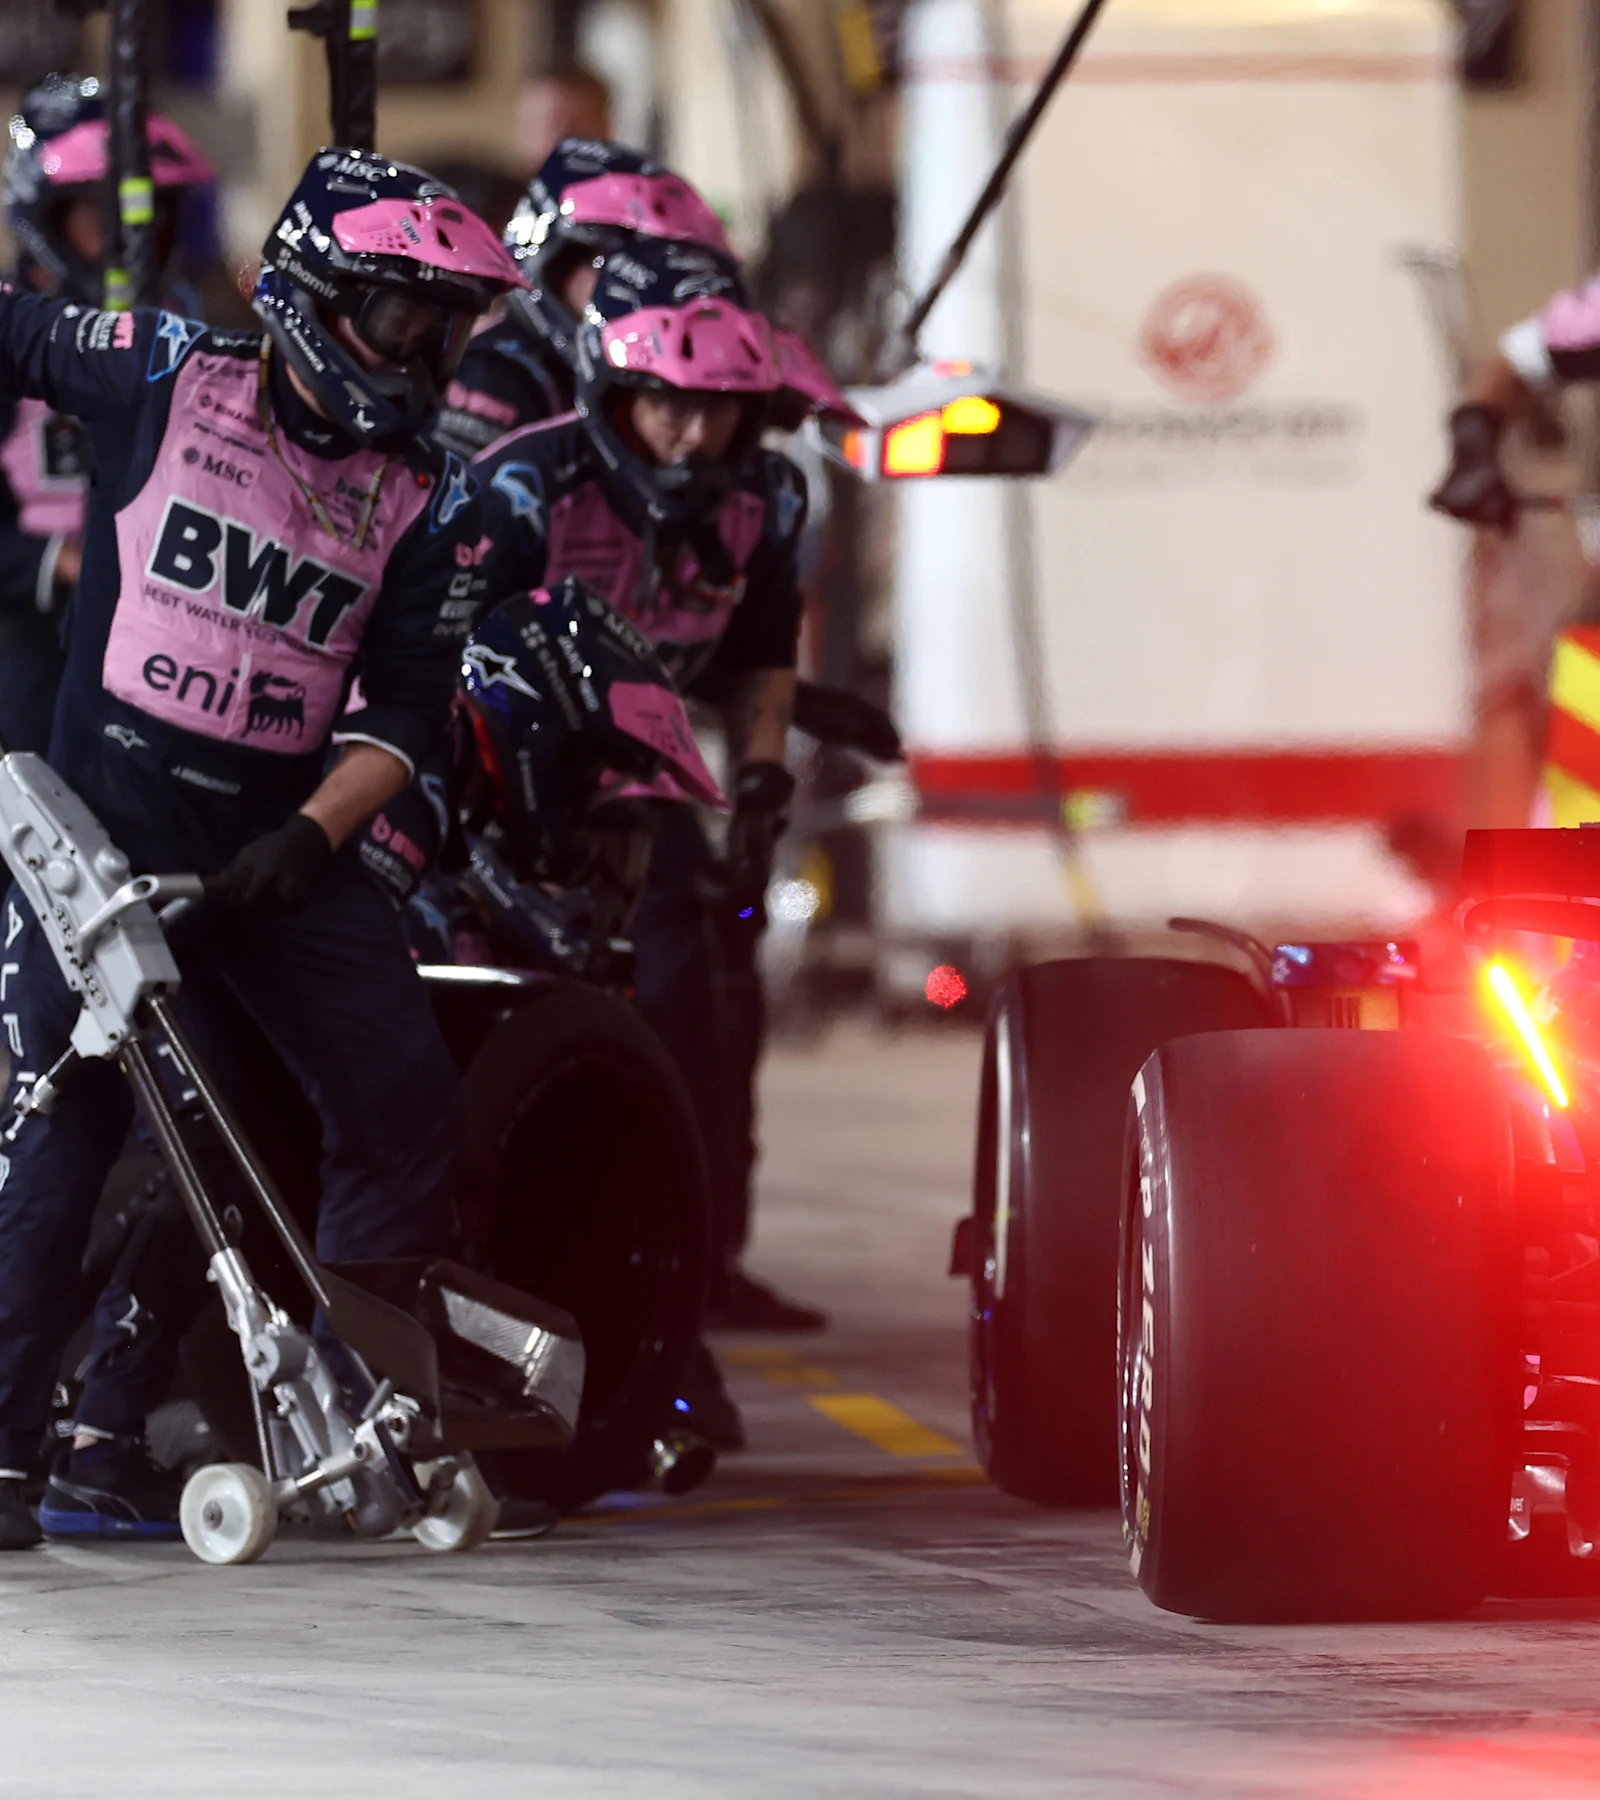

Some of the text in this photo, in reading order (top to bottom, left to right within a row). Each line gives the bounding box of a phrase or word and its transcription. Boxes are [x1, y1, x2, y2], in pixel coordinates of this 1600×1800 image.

[203, 455, 252, 488] MSC
[148, 496, 369, 650] BWT
[187, 602, 240, 633] WATER
[142, 653, 240, 717] eni
[1139, 1237, 1155, 1476] ZERO
